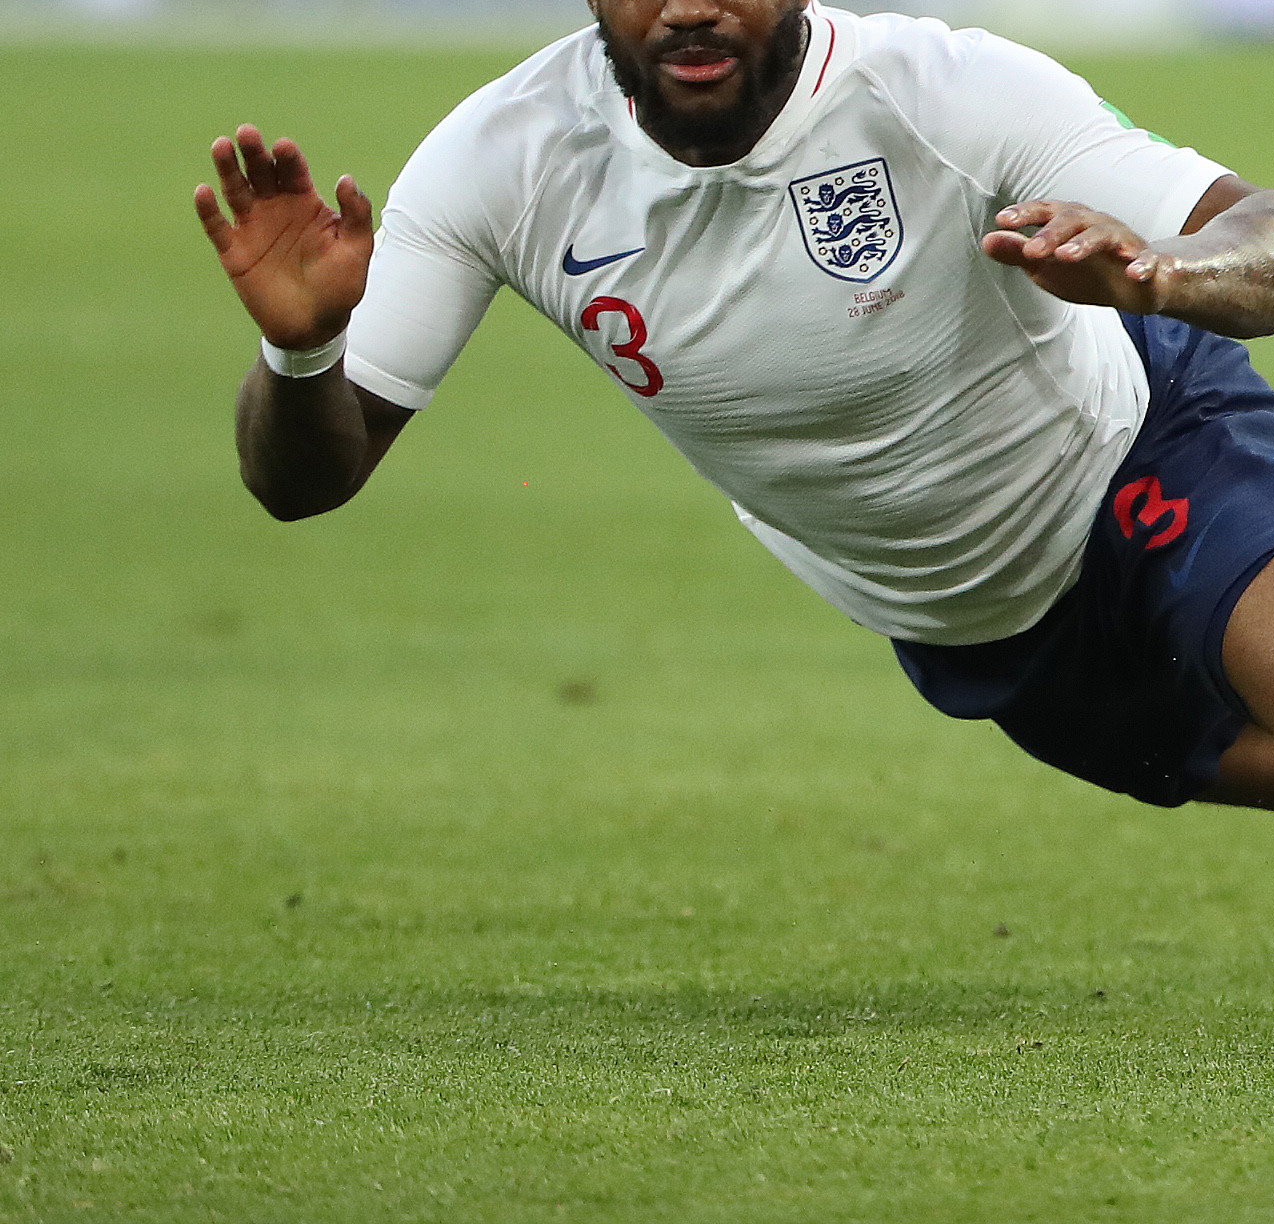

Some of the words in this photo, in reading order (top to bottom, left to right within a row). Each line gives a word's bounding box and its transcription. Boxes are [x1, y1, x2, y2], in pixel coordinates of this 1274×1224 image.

[847, 307, 860, 318] 28
[862, 300, 884, 315] JUNE
[853, 288, 892, 305] BELGIUM
[580, 295, 664, 397] 3
[1112, 475, 1190, 550] 3
